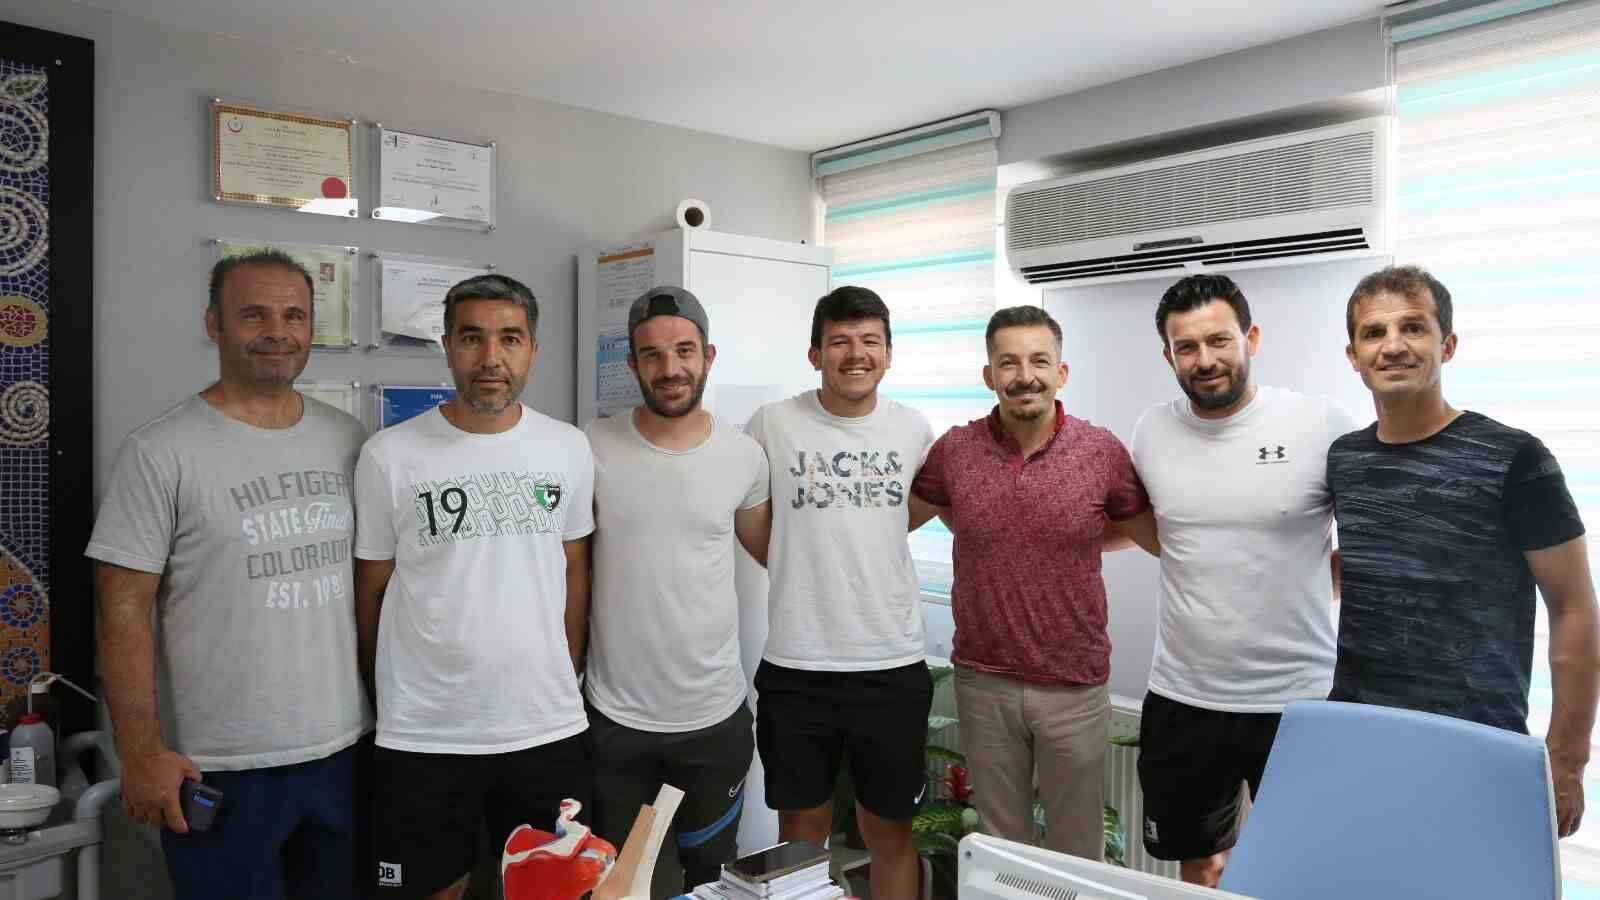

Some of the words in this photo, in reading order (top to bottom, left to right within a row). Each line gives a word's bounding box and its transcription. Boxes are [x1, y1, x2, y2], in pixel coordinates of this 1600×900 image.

[790, 450, 902, 477] JACK&
[230, 470, 350, 512] HILFIGER
[791, 480, 903, 510] JONES
[242, 507, 303, 545] STATE
[418, 487, 468, 536] 19
[247, 538, 348, 579] COLORADO
[265, 580, 308, 608] EST.
